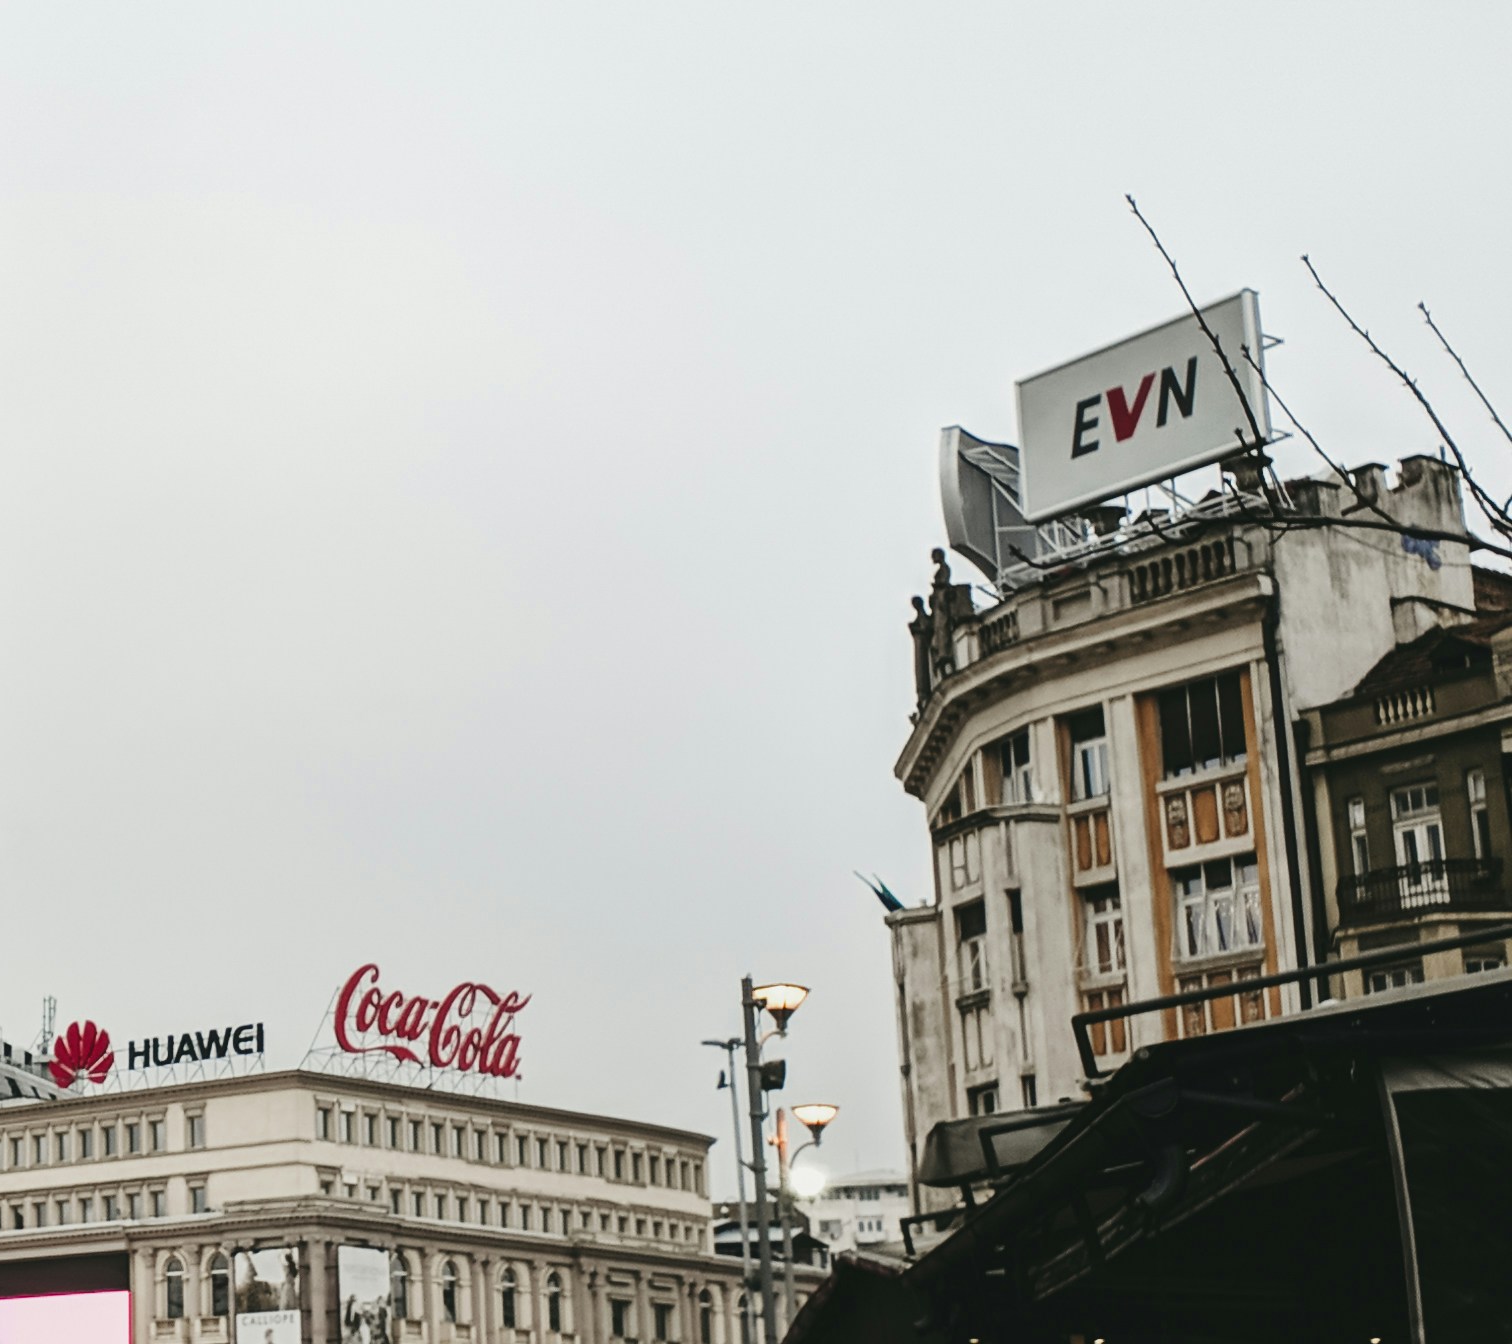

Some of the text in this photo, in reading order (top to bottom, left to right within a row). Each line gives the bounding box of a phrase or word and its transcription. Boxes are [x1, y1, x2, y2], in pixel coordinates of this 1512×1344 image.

[1071, 356, 1197, 460] EVN
[128, 1022, 265, 1070] HUAWEI
[333, 963, 533, 1079] Coca-Cola
[241, 1313, 295, 1327] CALLIOPE
